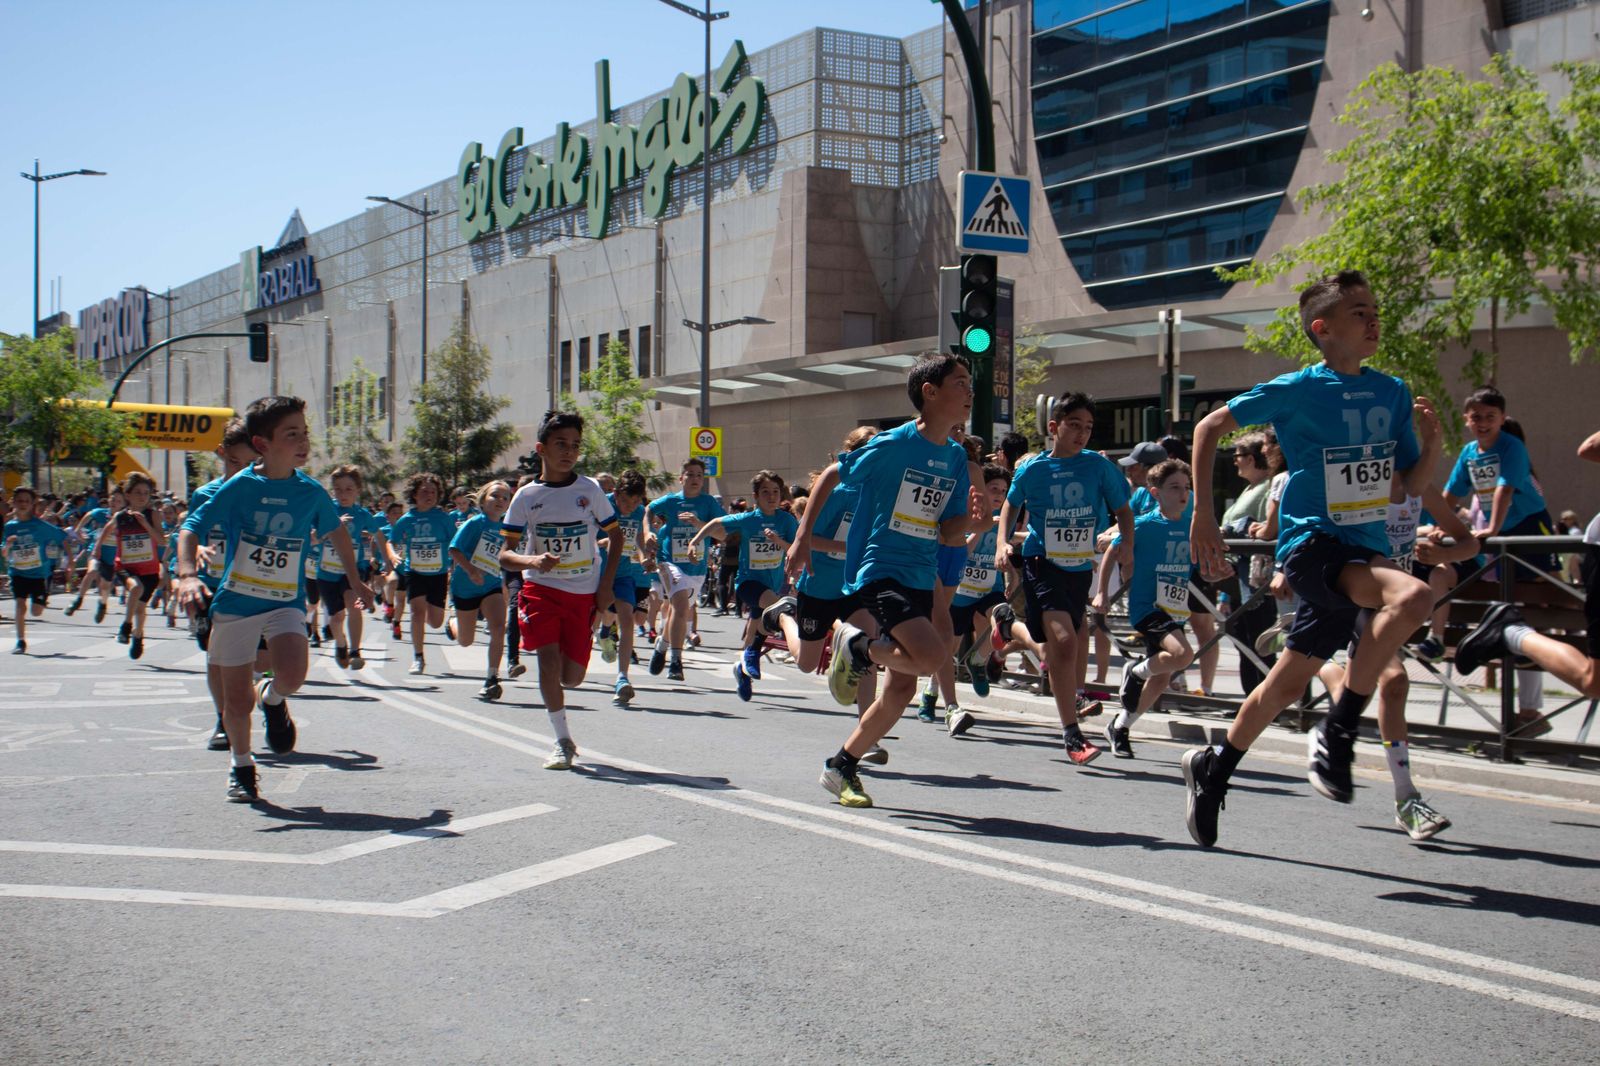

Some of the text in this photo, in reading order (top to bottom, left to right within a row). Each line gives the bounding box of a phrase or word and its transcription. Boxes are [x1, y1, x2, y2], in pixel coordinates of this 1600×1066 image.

[77, 288, 148, 361] HIPERCOR
[700, 436, 713, 444] 30
[1341, 460, 1391, 485] 1636
[912, 487, 946, 508] 159
[1054, 529, 1089, 542] 1673
[544, 537, 581, 553] 1371
[249, 548, 288, 569] 436
[415, 550, 438, 559] 1565
[965, 568, 987, 580] 930
